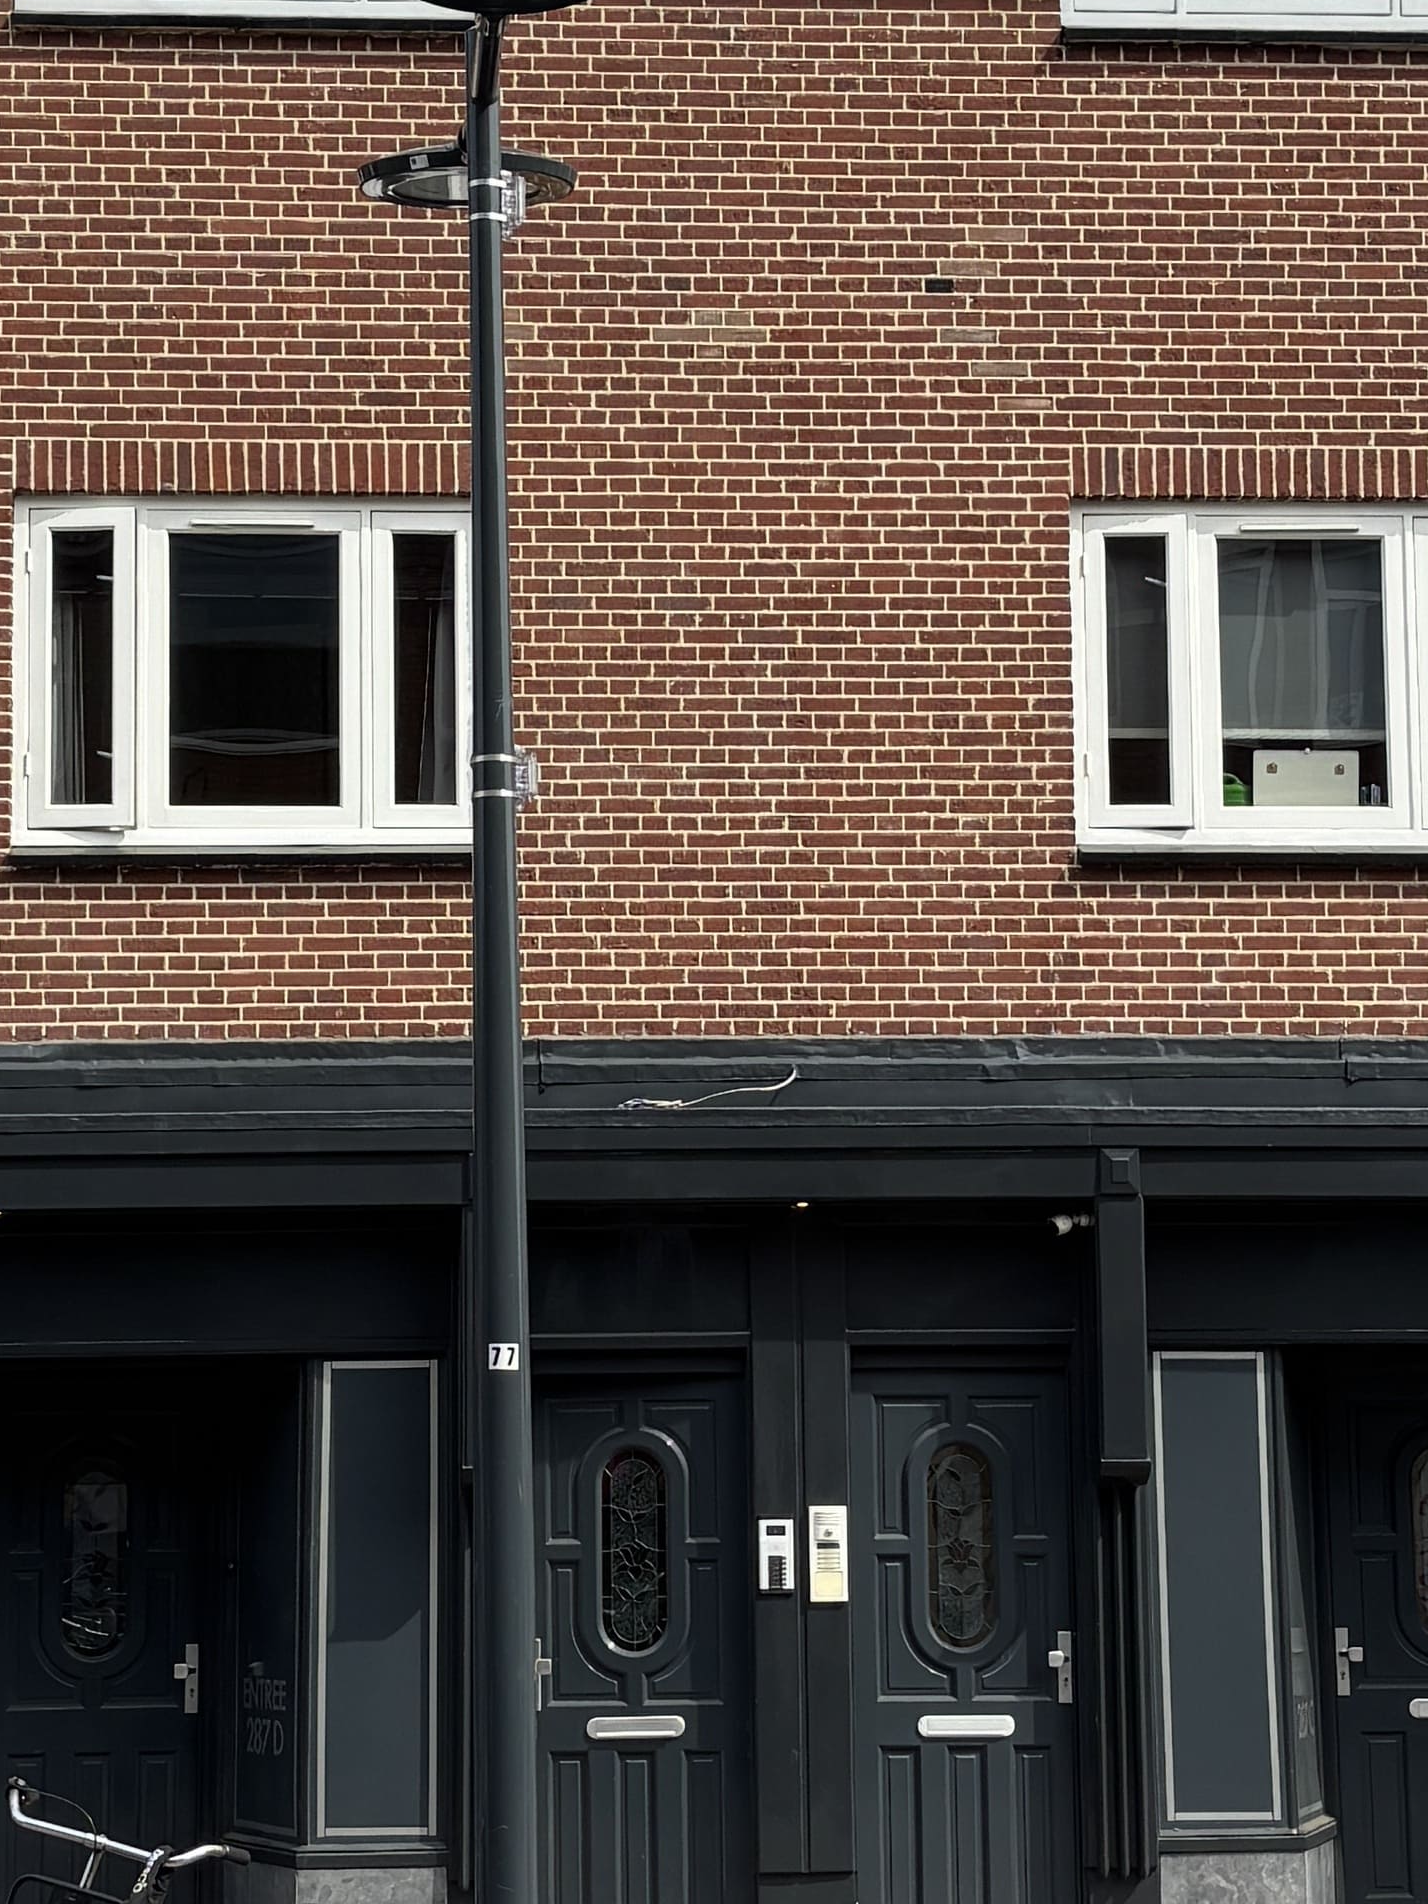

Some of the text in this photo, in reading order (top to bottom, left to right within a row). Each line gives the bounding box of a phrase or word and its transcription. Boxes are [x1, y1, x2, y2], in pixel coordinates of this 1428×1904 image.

[491, 1346, 515, 1366] 77
[244, 1678, 286, 1711] ENTREE
[246, 1717, 284, 1755] 287 D
